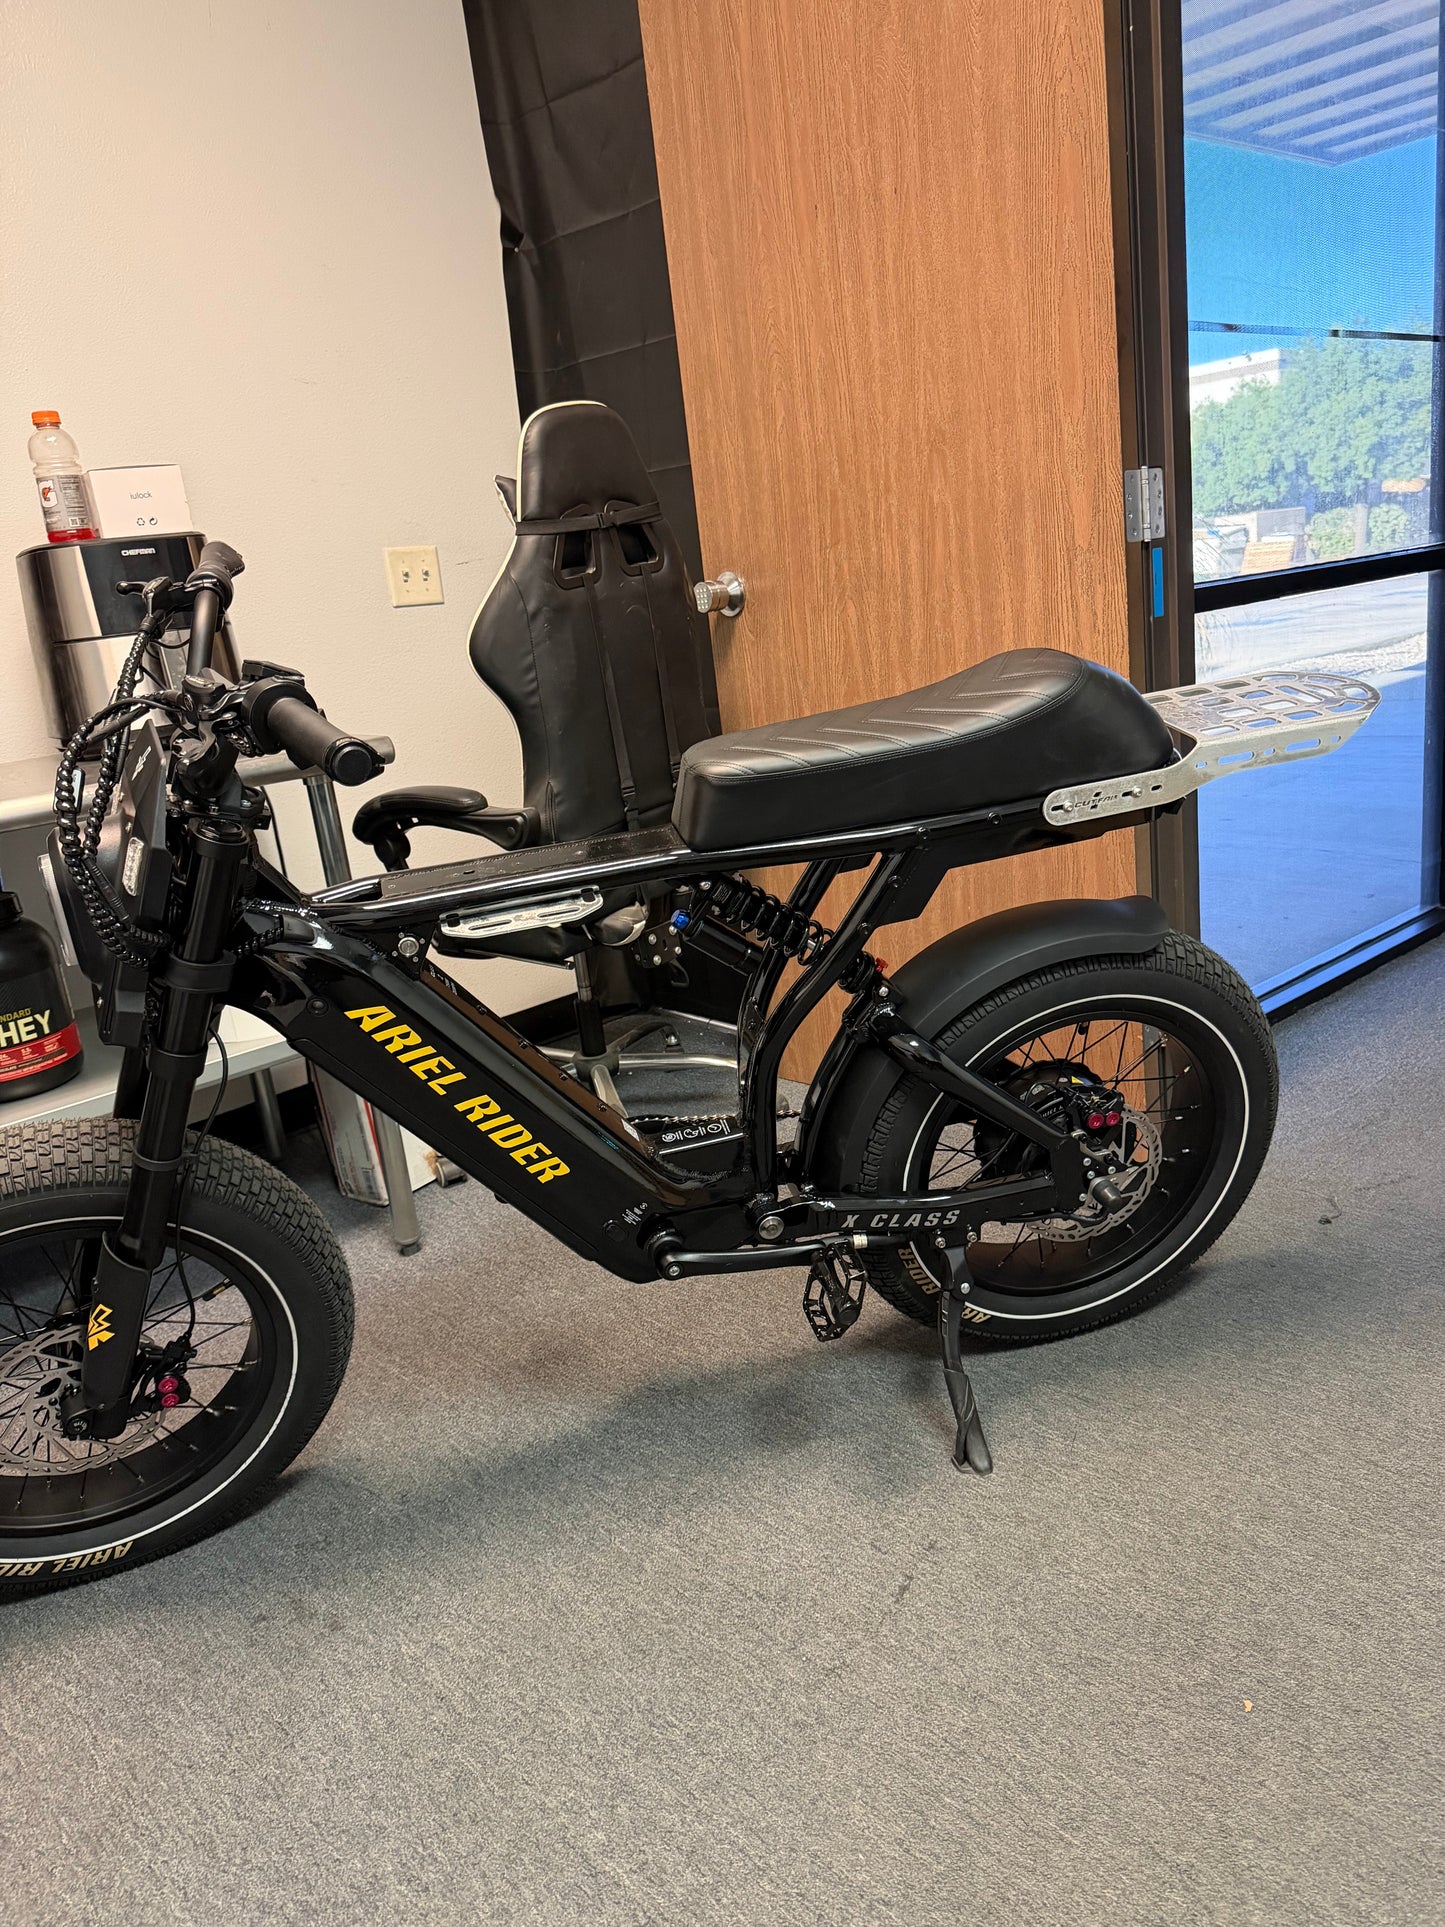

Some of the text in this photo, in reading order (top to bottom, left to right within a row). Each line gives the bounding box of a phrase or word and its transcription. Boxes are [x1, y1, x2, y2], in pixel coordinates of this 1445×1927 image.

[344, 1005, 467, 1096] ARIEL
[453, 1094, 571, 1184] RIDER
[841, 1209, 960, 1228] X CLASS
[897, 1248, 942, 1295] RIDER
[51, 1540, 134, 1574] ARIEL
